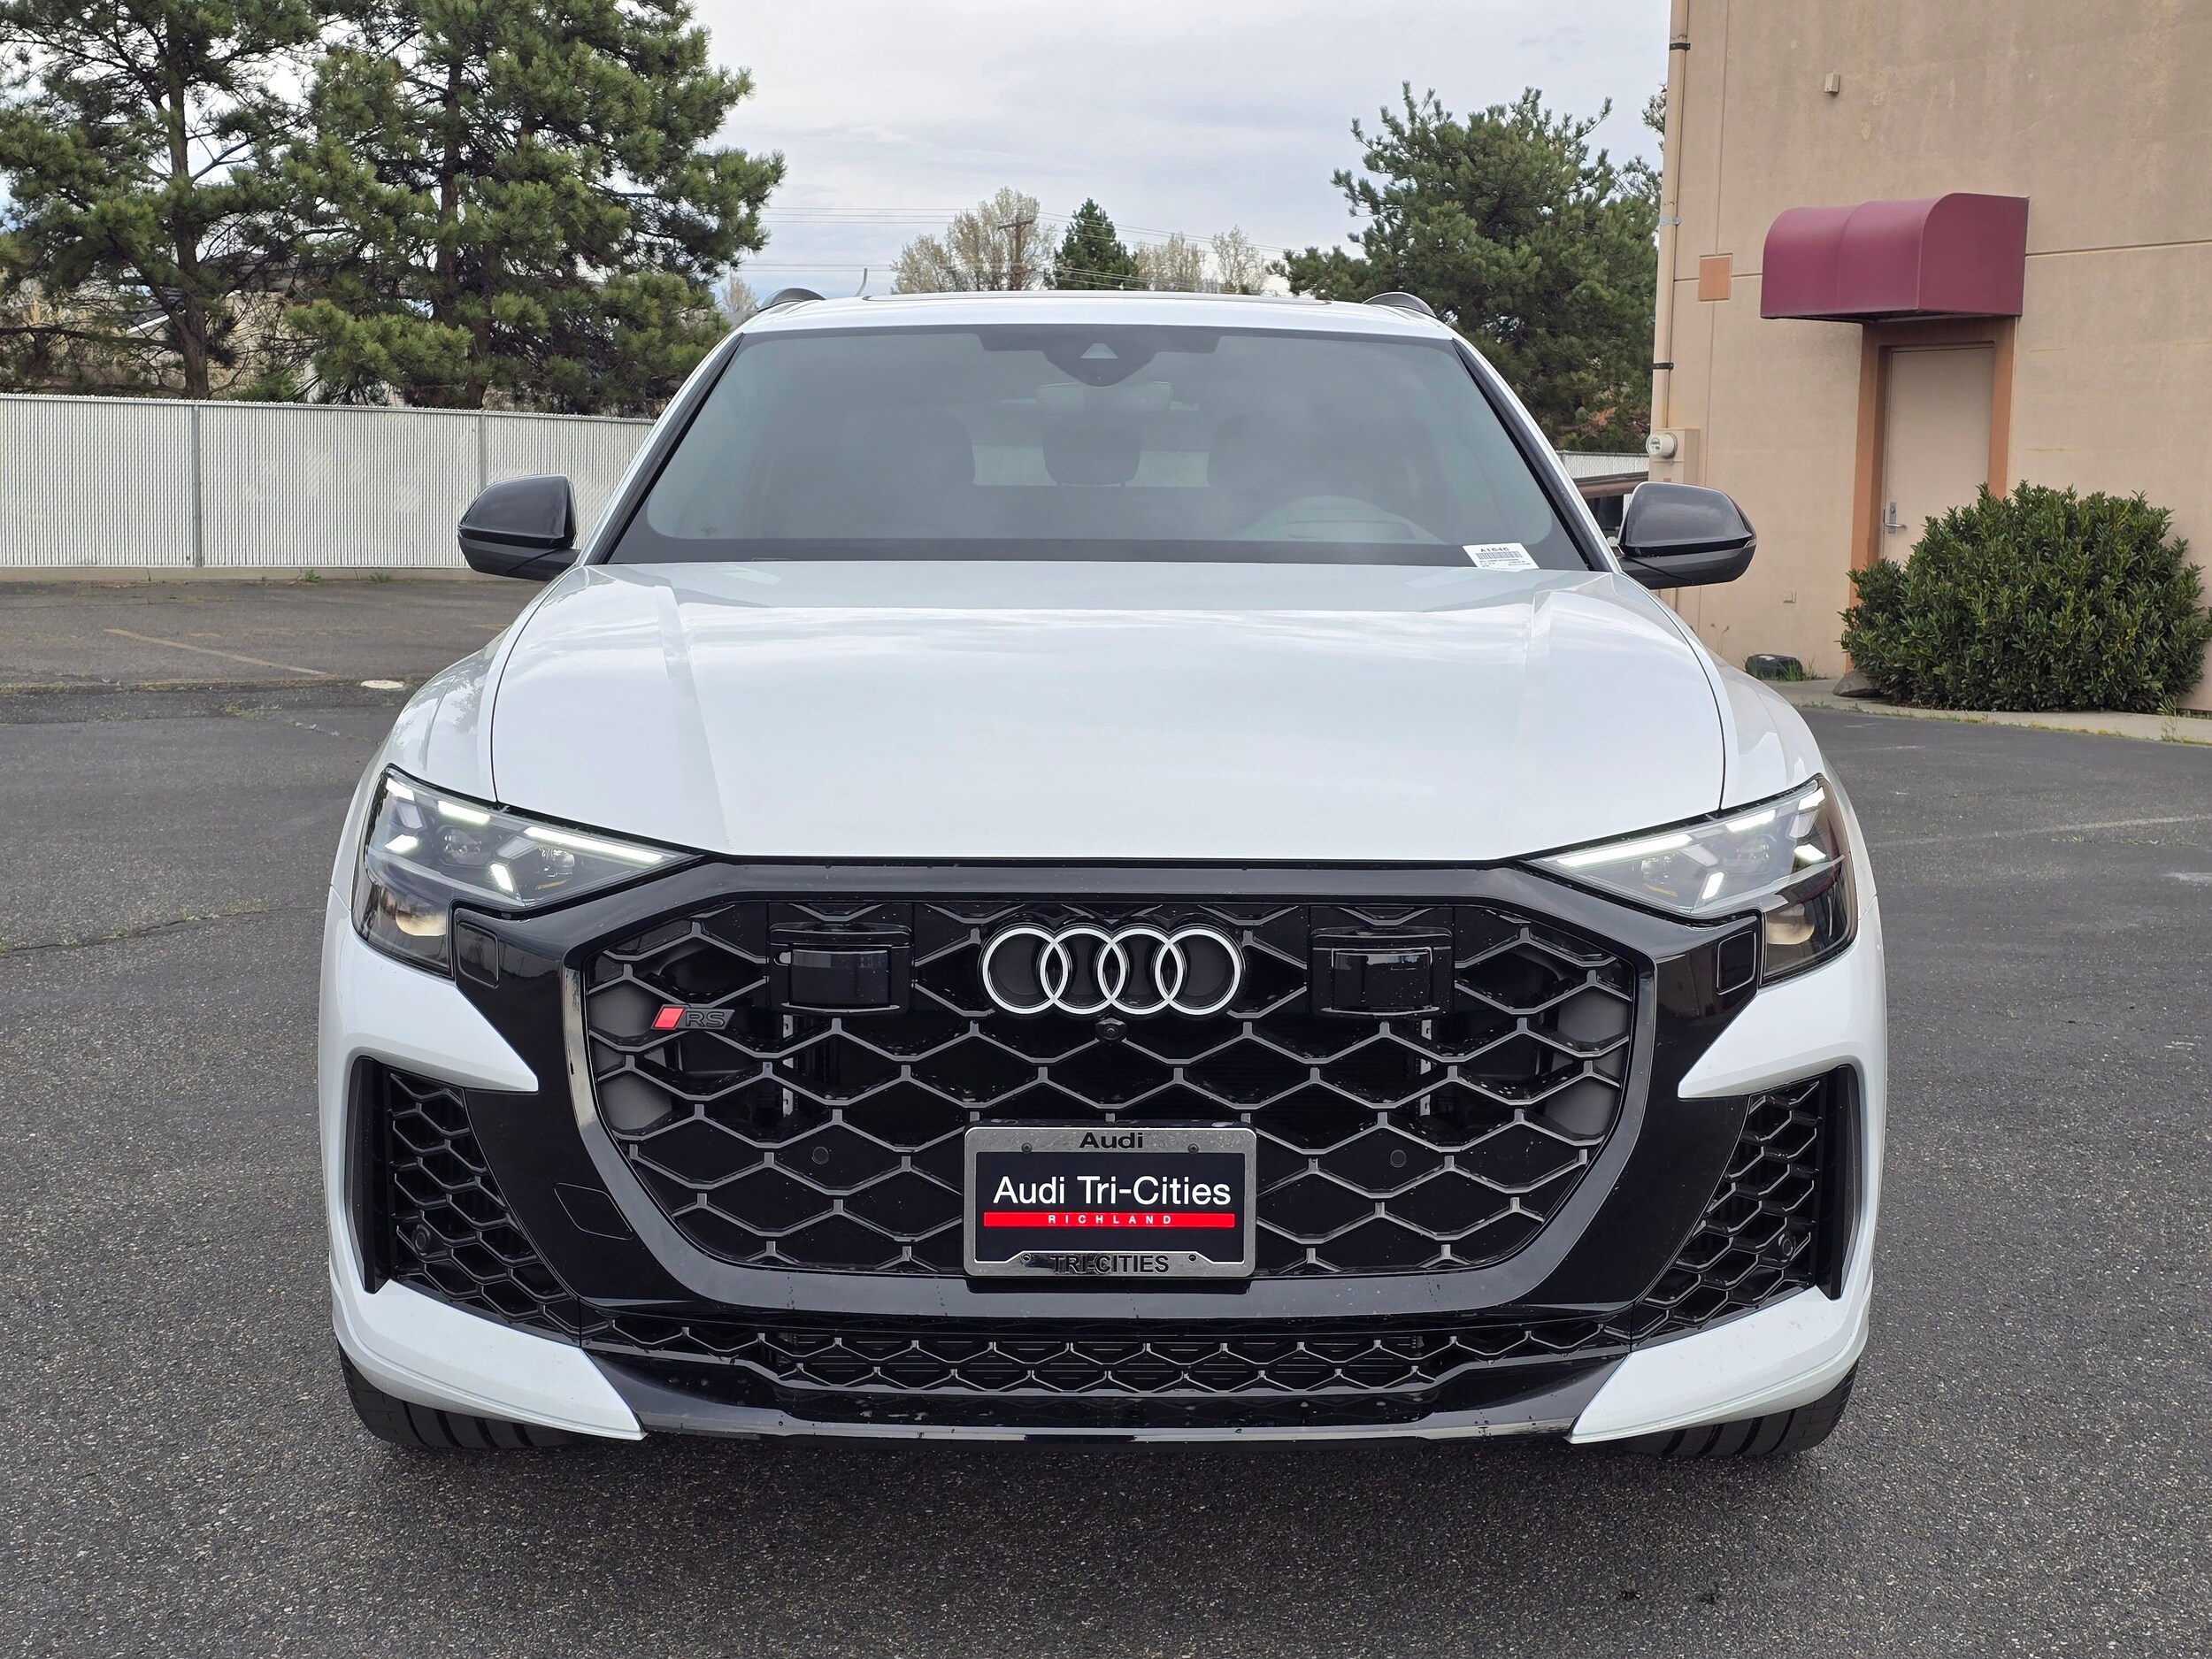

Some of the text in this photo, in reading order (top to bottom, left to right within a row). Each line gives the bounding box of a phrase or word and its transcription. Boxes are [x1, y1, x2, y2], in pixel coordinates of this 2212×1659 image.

[685, 1010, 725, 1028] RS
[1079, 1132, 1143, 1148] Audi
[993, 1176, 1232, 1205] Audi Tri-Cities
[1048, 1215, 1171, 1225] RICHLAND
